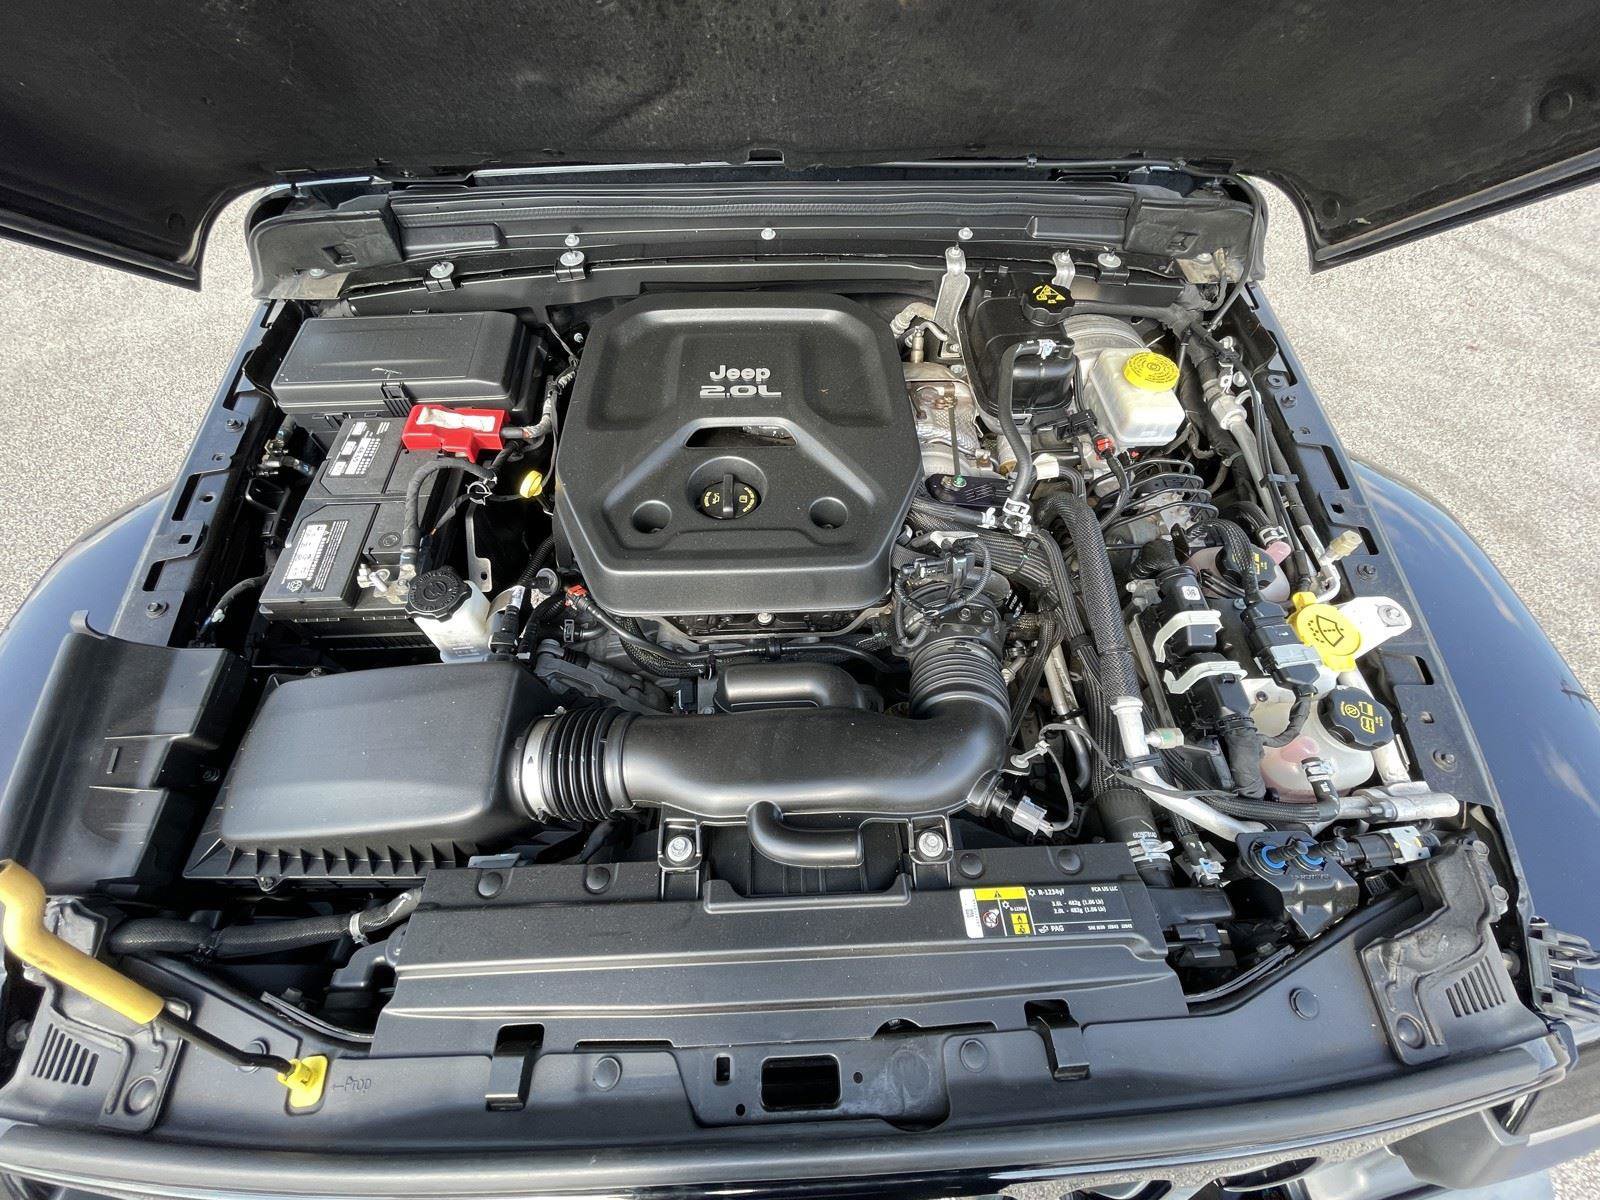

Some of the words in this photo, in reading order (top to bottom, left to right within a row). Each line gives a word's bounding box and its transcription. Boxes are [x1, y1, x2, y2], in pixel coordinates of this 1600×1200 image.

[709, 364, 771, 383] Jeep
[700, 385, 782, 399] 2.0L
[1037, 888, 1065, 896] R-1234yf
